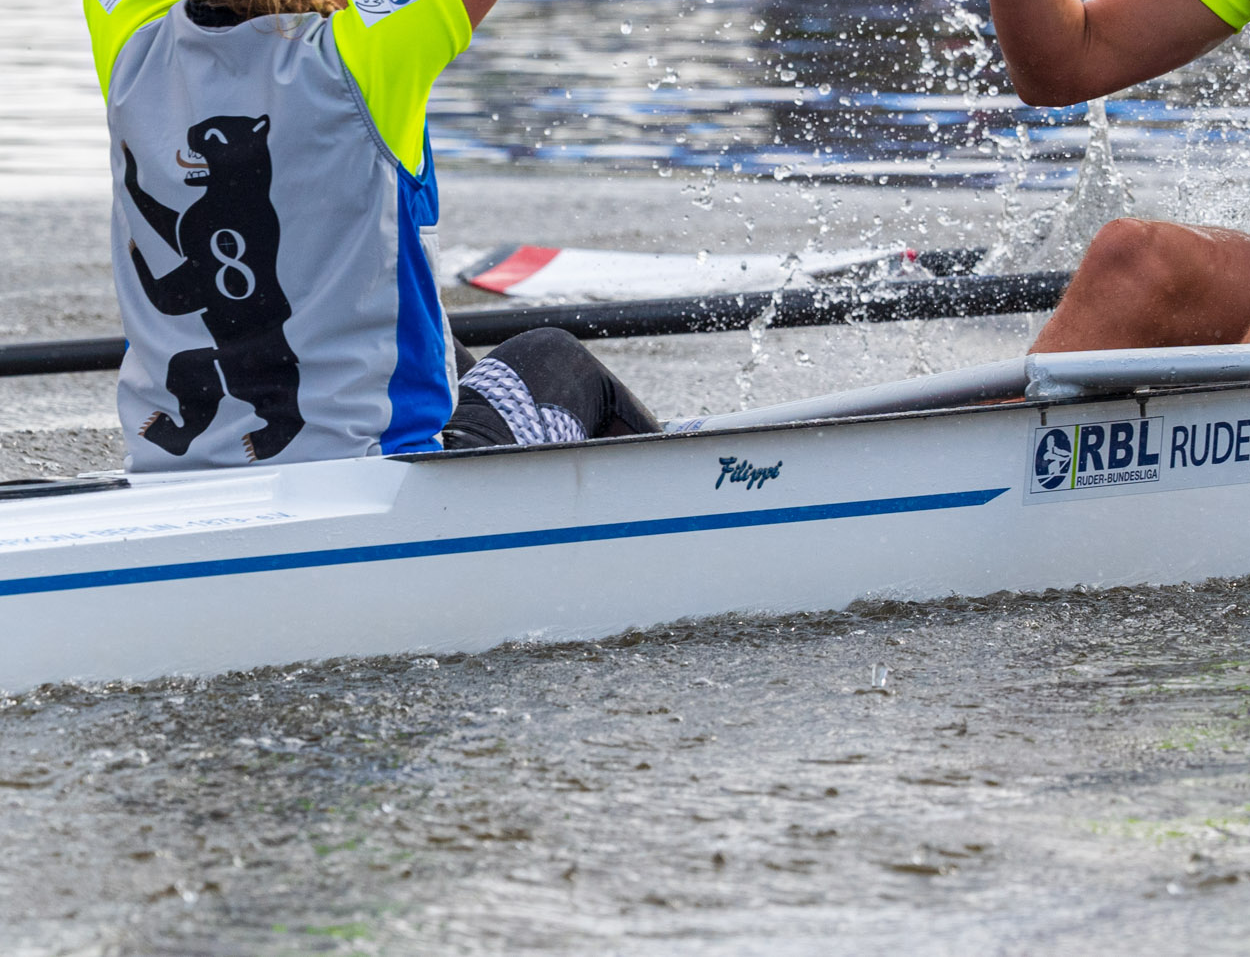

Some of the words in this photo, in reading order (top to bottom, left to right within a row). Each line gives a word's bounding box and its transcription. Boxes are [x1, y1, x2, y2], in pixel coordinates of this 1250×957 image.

[210, 229, 256, 300] 8
[1077, 415, 1160, 473] RBL
[715, 456, 783, 491] Filippi
[1075, 468, 1159, 487] RUDER-BUNDESLIGA
